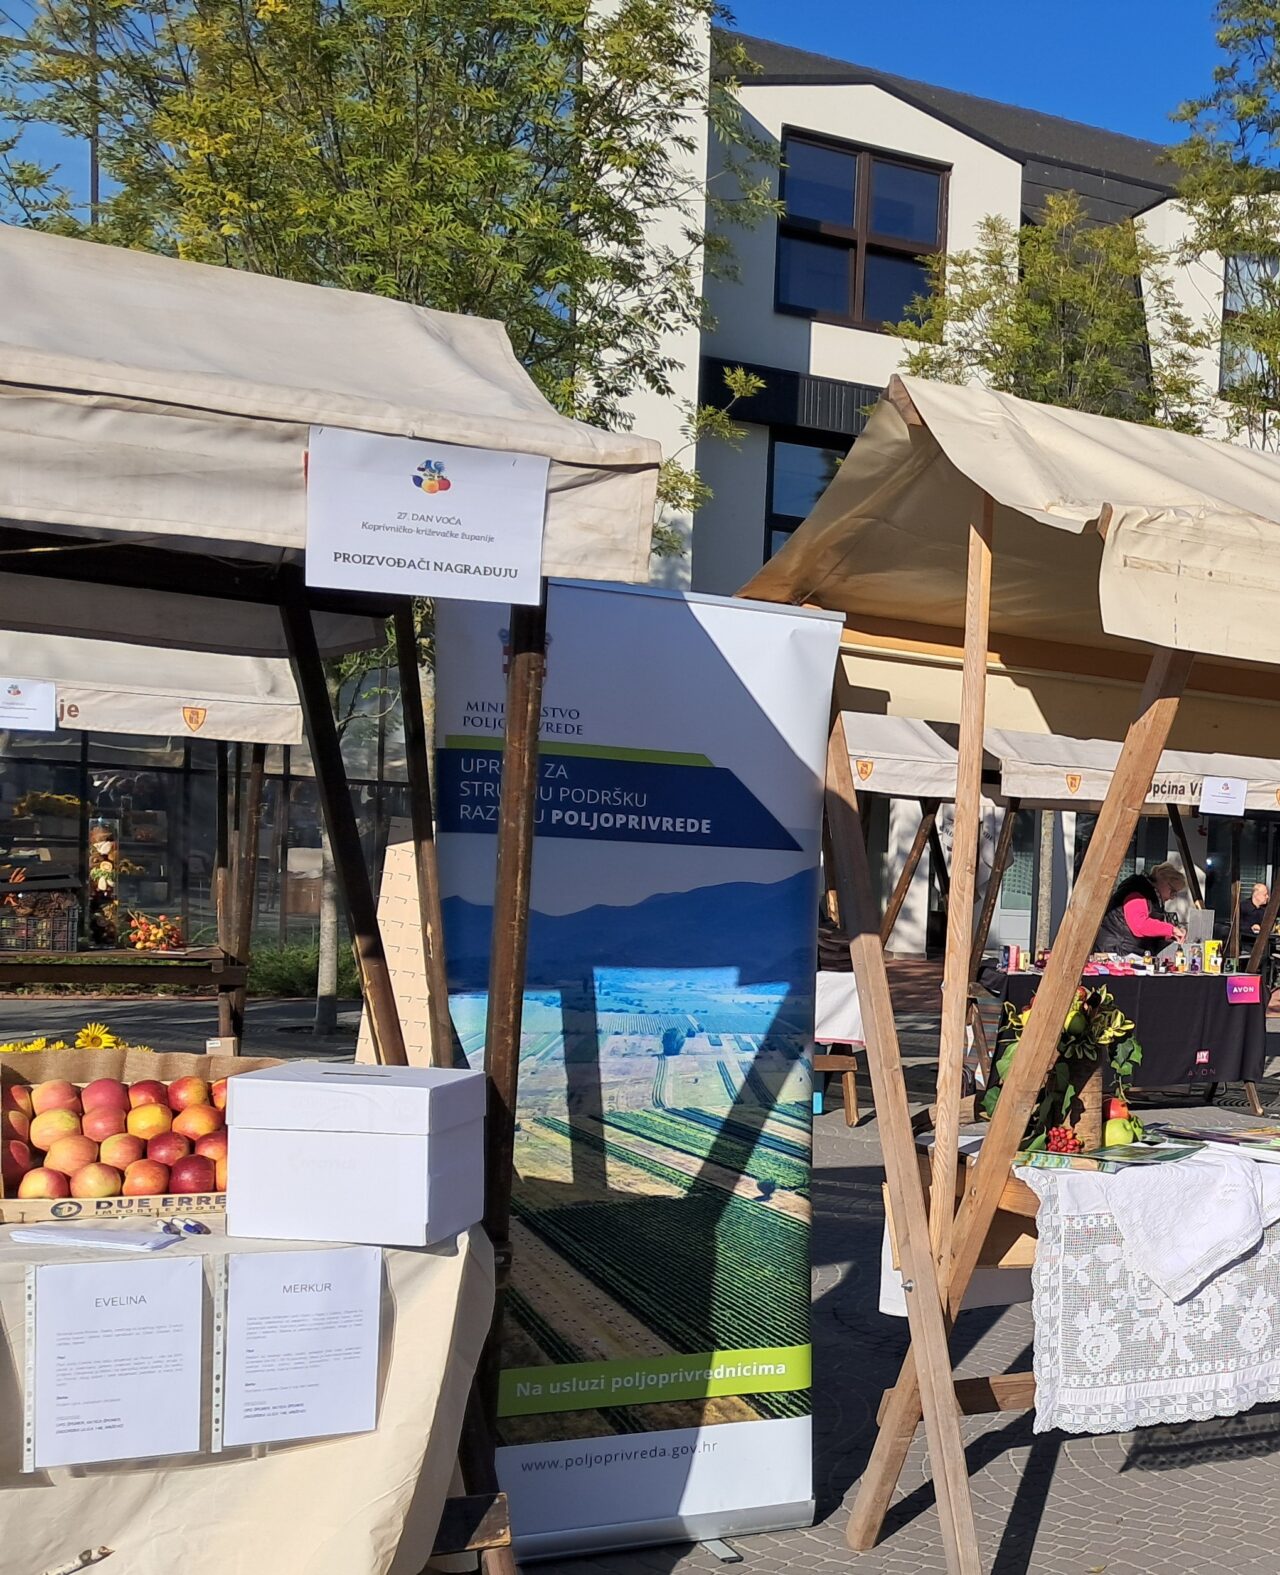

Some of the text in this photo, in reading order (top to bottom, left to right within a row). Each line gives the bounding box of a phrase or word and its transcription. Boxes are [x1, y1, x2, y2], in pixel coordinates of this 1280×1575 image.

[411, 512, 433, 523] DAN
[435, 513, 462, 526] VOĆA
[461, 531, 495, 544] županije
[333, 551, 519, 580] PROIZVOĐAČI NAGRAĐUJU
[544, 763, 568, 779] ZA
[559, 785, 648, 808] PODRŠKU
[551, 810, 712, 834] POLJOPRIVREDE
[1232, 985, 1255, 994] AVON
[95, 1194, 227, 1210] DUE ERRE
[282, 1281, 332, 1295] MERKUR
[94, 1293, 147, 1309] EVELINA
[516, 1361, 787, 1397] Na usluzi poljoprivrednicima
[521, 1440, 719, 1473] www.poljoprivreda.gov.hr
